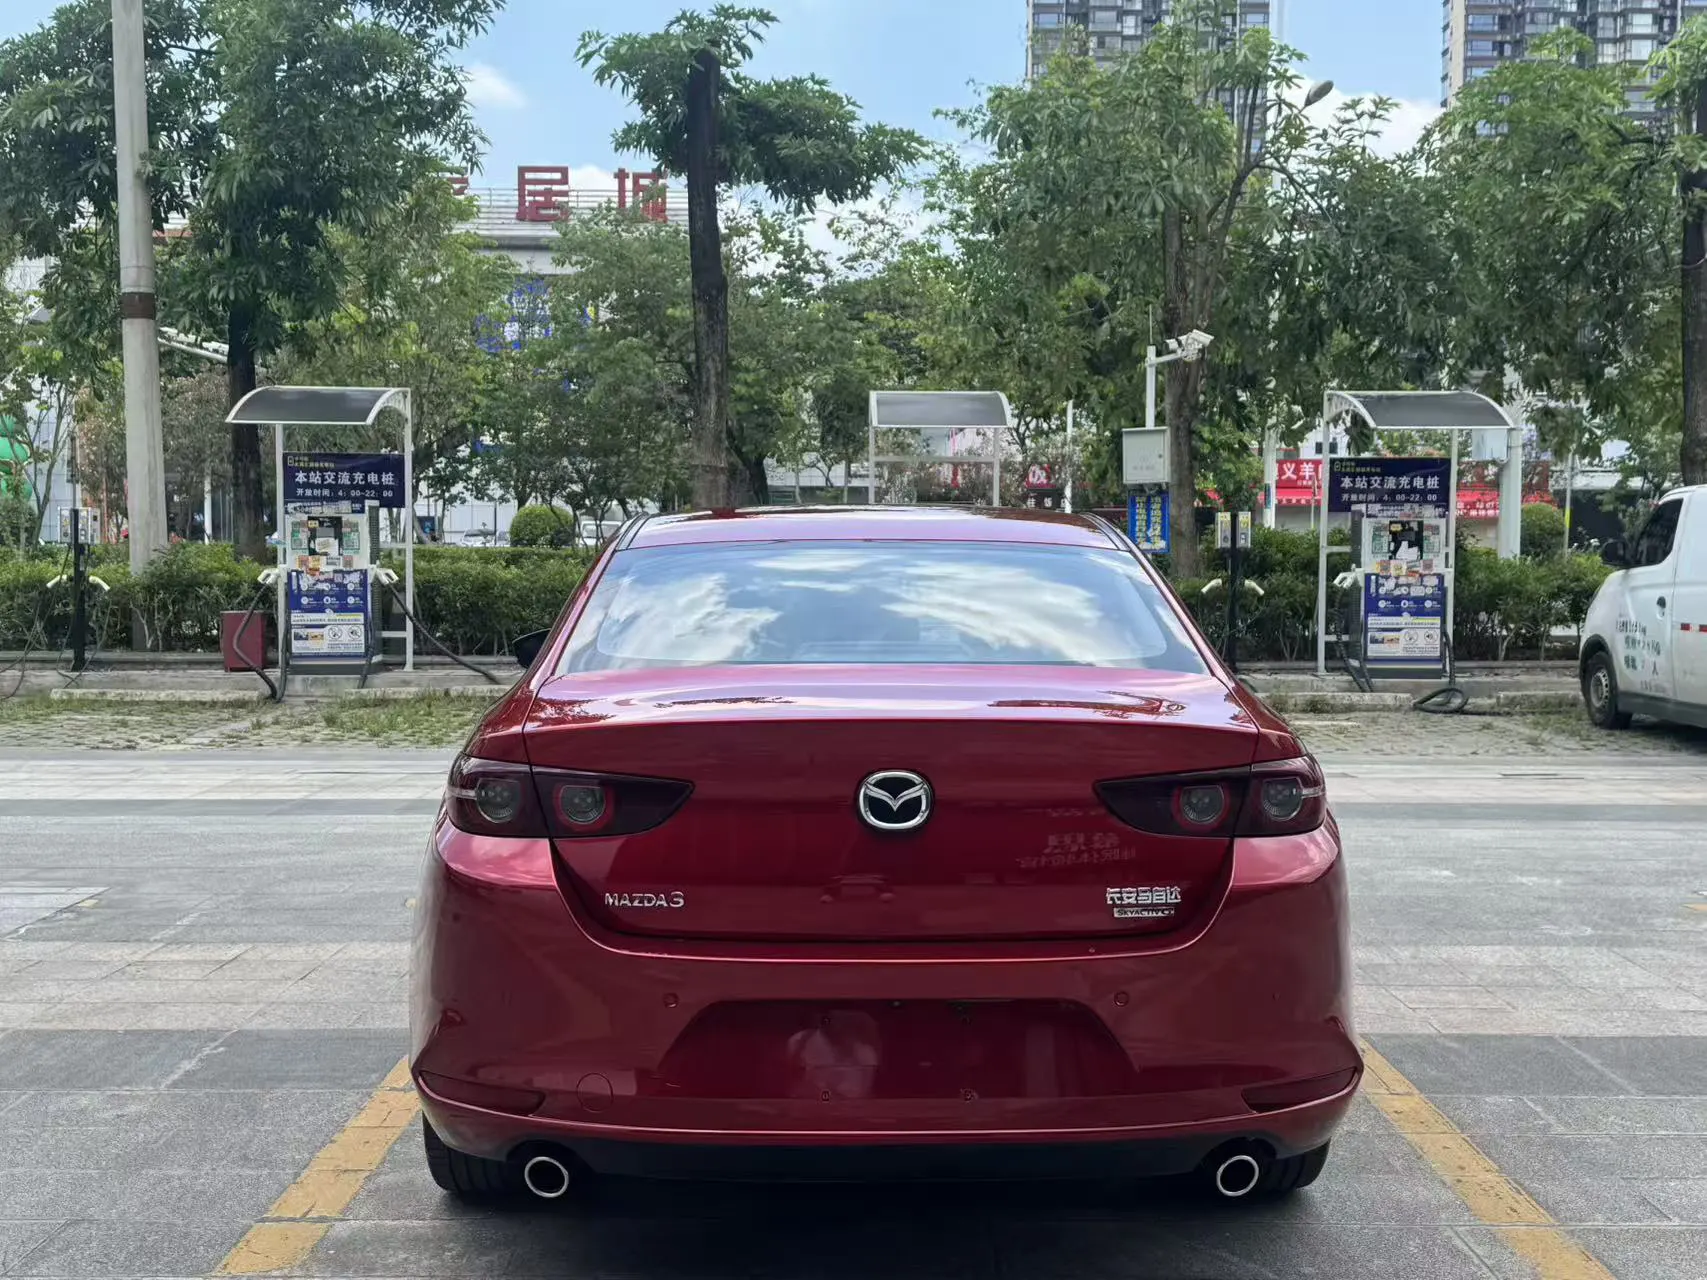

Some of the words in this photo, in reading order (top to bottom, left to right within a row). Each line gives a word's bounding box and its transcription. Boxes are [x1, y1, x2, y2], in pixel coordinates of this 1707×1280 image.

[295, 471, 395, 485] 本站交流充电桩
[1276, 461, 1322, 480] 义羊
[1340, 475, 1440, 489] 本站交流充电桩
[604, 891, 685, 908] MAZDA3
[1106, 886, 1182, 904] 长安马自达
